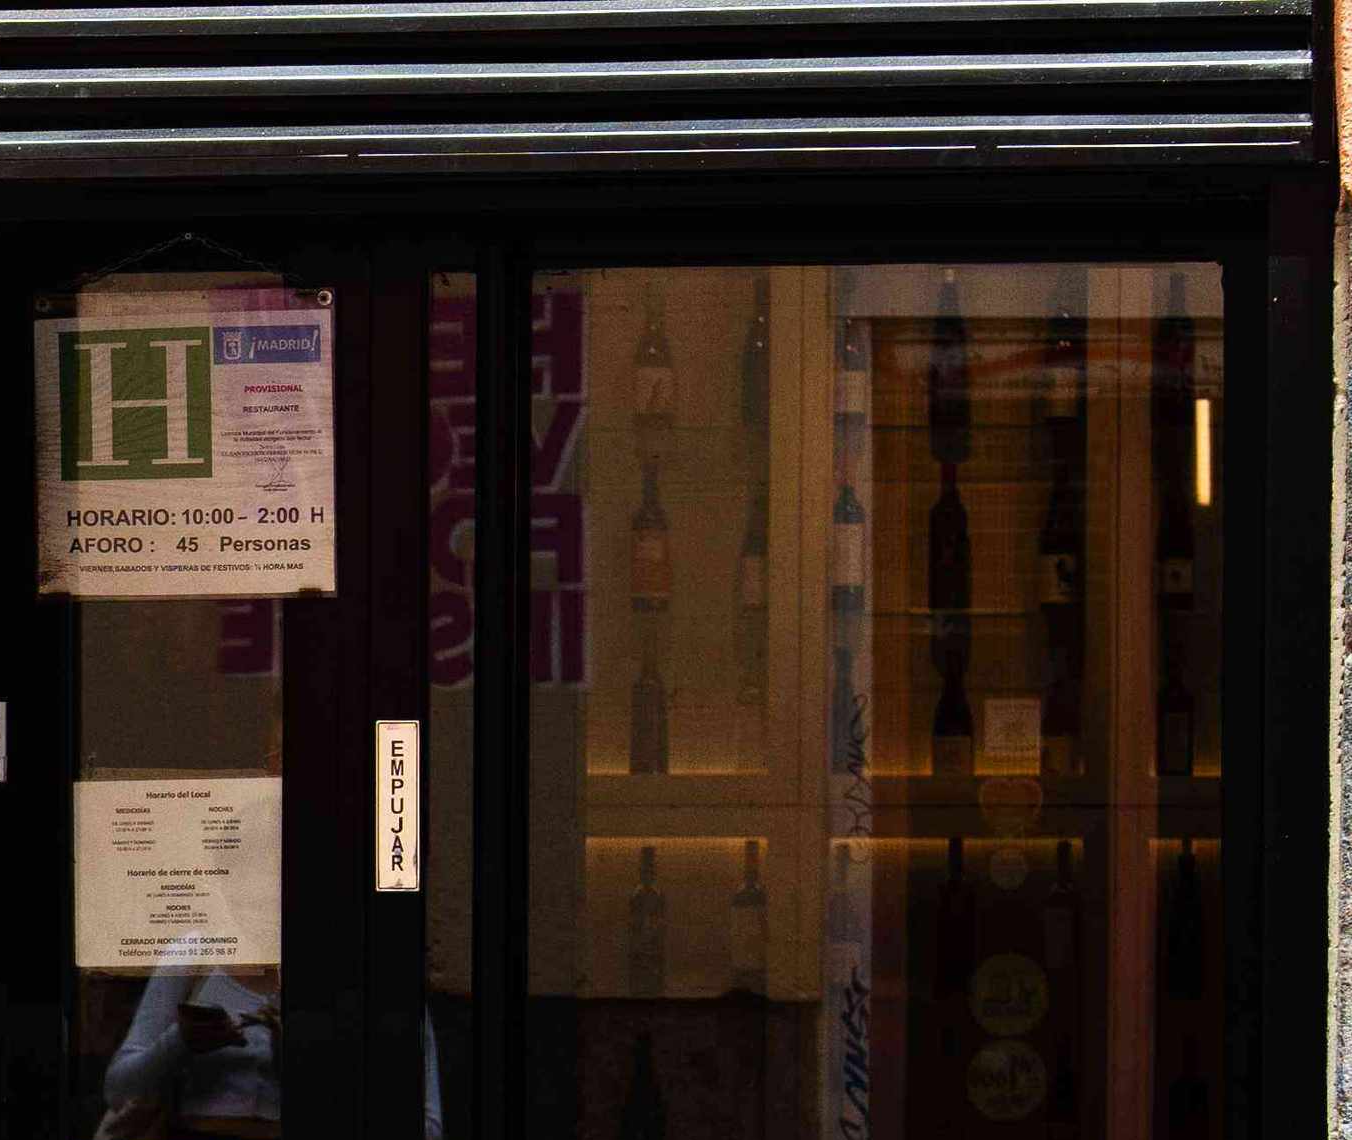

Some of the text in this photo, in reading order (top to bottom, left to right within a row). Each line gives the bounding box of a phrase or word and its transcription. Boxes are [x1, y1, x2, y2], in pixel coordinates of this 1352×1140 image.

[248, 329, 319, 359] ¡MADRID!
[244, 384, 303, 393] PROVISIONAL
[74, 340, 204, 466] H
[243, 404, 300, 413] RESTAURANTE
[67, 508, 177, 527] HORARIO:
[182, 508, 234, 525] 10:00
[257, 507, 299, 524] 2:00
[310, 507, 324, 523] H
[176, 536, 199, 553] 45
[219, 535, 312, 552] Personas
[262, 563, 286, 571] HORA
[286, 562, 304, 570] MAS
[146, 790, 211, 799] Horario del Local
[390, 740, 404, 872] EMPUJAR
[127, 869, 156, 877] Horario
[158, 869, 168, 877] de
[193, 868, 203, 876] de
[204, 868, 229, 876] cocina
[121, 938, 156, 946] CERRADO
[157, 937, 187, 945] NOCHES
[200, 936, 238, 944] DOMINGO
